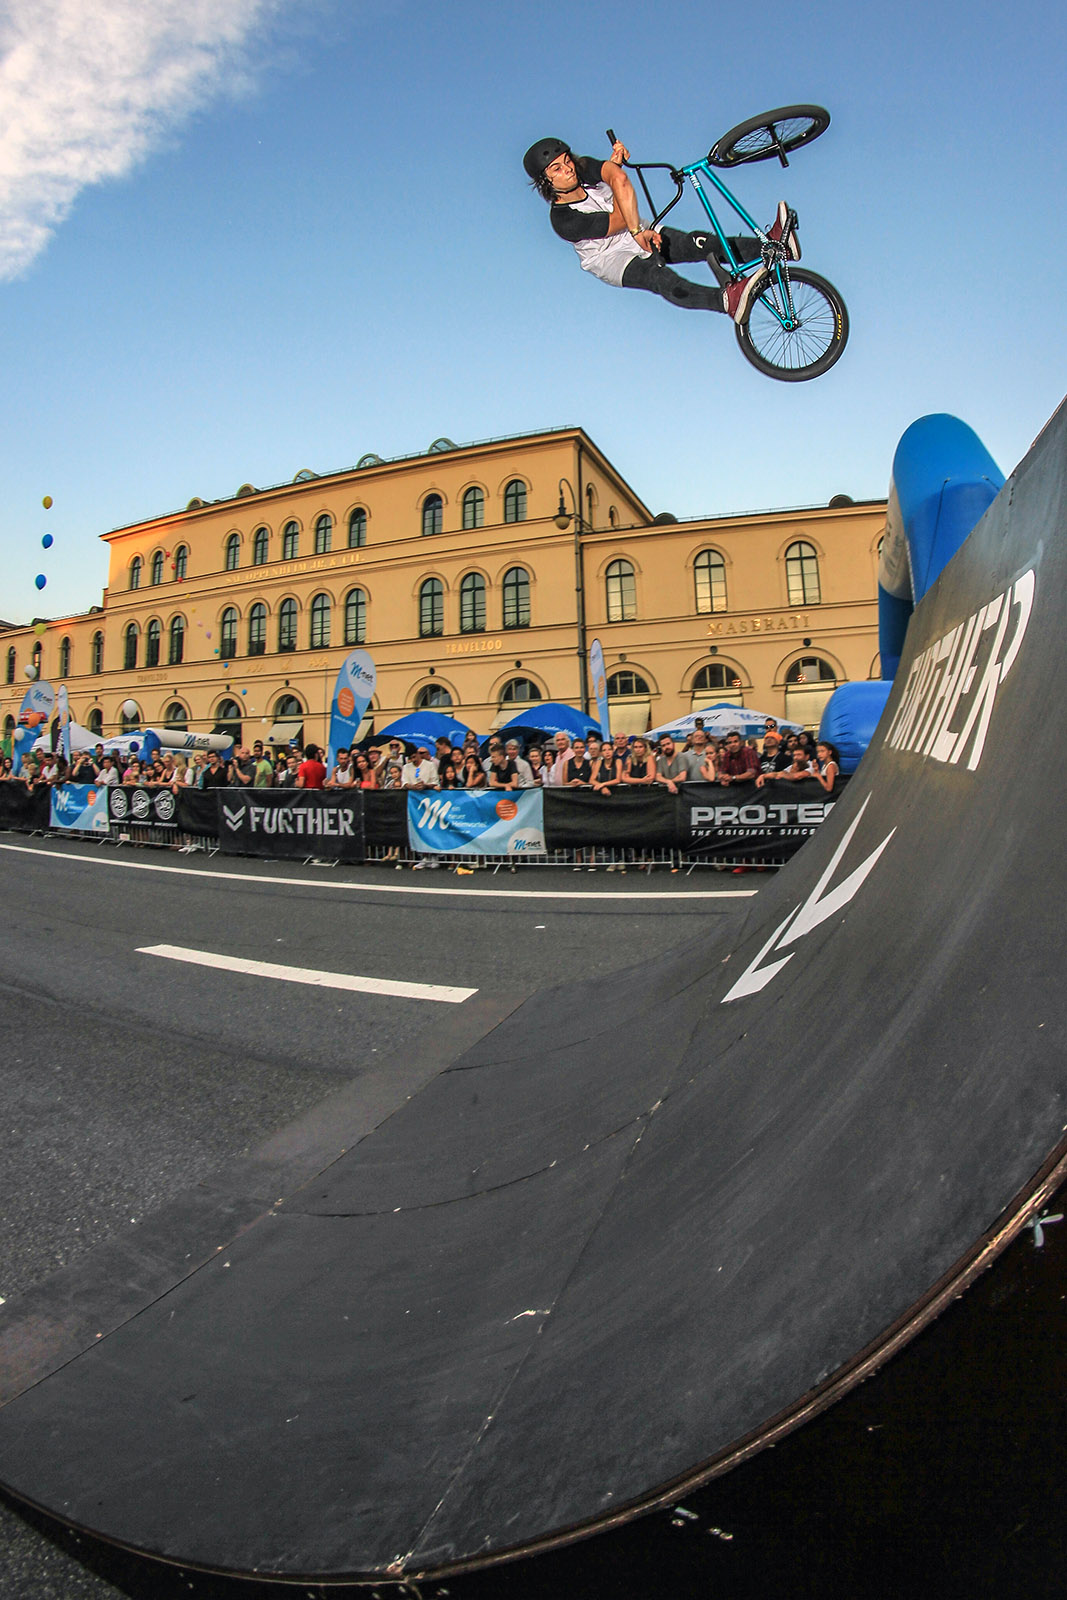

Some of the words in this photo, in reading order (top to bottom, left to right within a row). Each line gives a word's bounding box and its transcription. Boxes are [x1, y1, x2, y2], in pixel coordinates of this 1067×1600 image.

[707, 615, 810, 636] MASERATI
[446, 640, 502, 654] TRAVELZOO
[883, 568, 1036, 772] FURTHER
[250, 806, 355, 836] FURTHER
